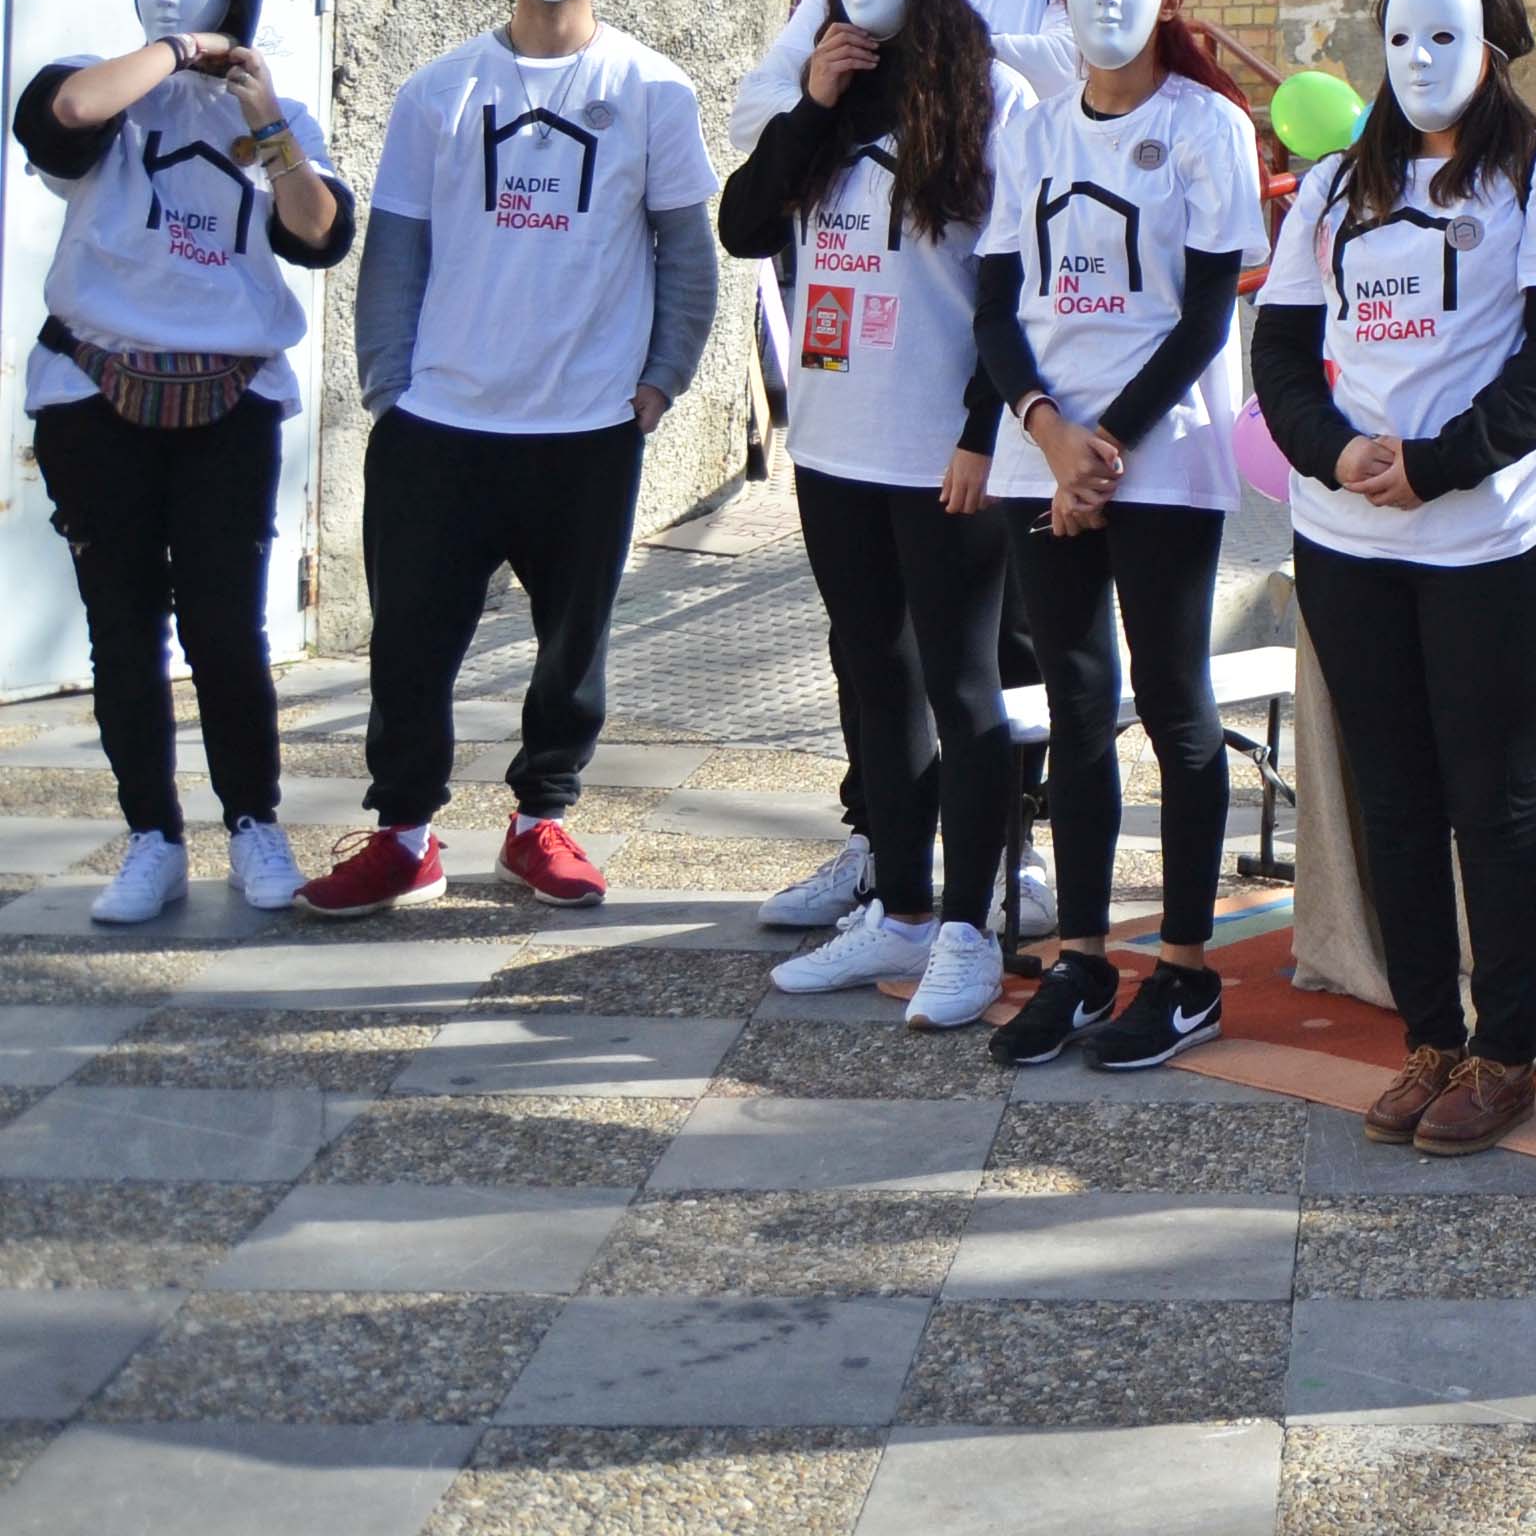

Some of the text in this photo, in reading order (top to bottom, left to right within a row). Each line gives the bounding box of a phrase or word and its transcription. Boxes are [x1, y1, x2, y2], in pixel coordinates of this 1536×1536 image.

[503, 176, 561, 193] NADIE
[498, 192, 532, 211] SIN
[496, 211, 570, 232] HOGAR
[817, 211, 871, 231] NADIE
[816, 231, 848, 251] SIN
[814, 252, 881, 273] HOGAR
[1059, 255, 1106, 274] ADIE
[1056, 275, 1080, 293] IN
[1356, 276, 1421, 300] NADIE
[1055, 295, 1126, 315] OGAR
[1357, 300, 1392, 322] SIN
[1356, 318, 1436, 342] HOGAR
